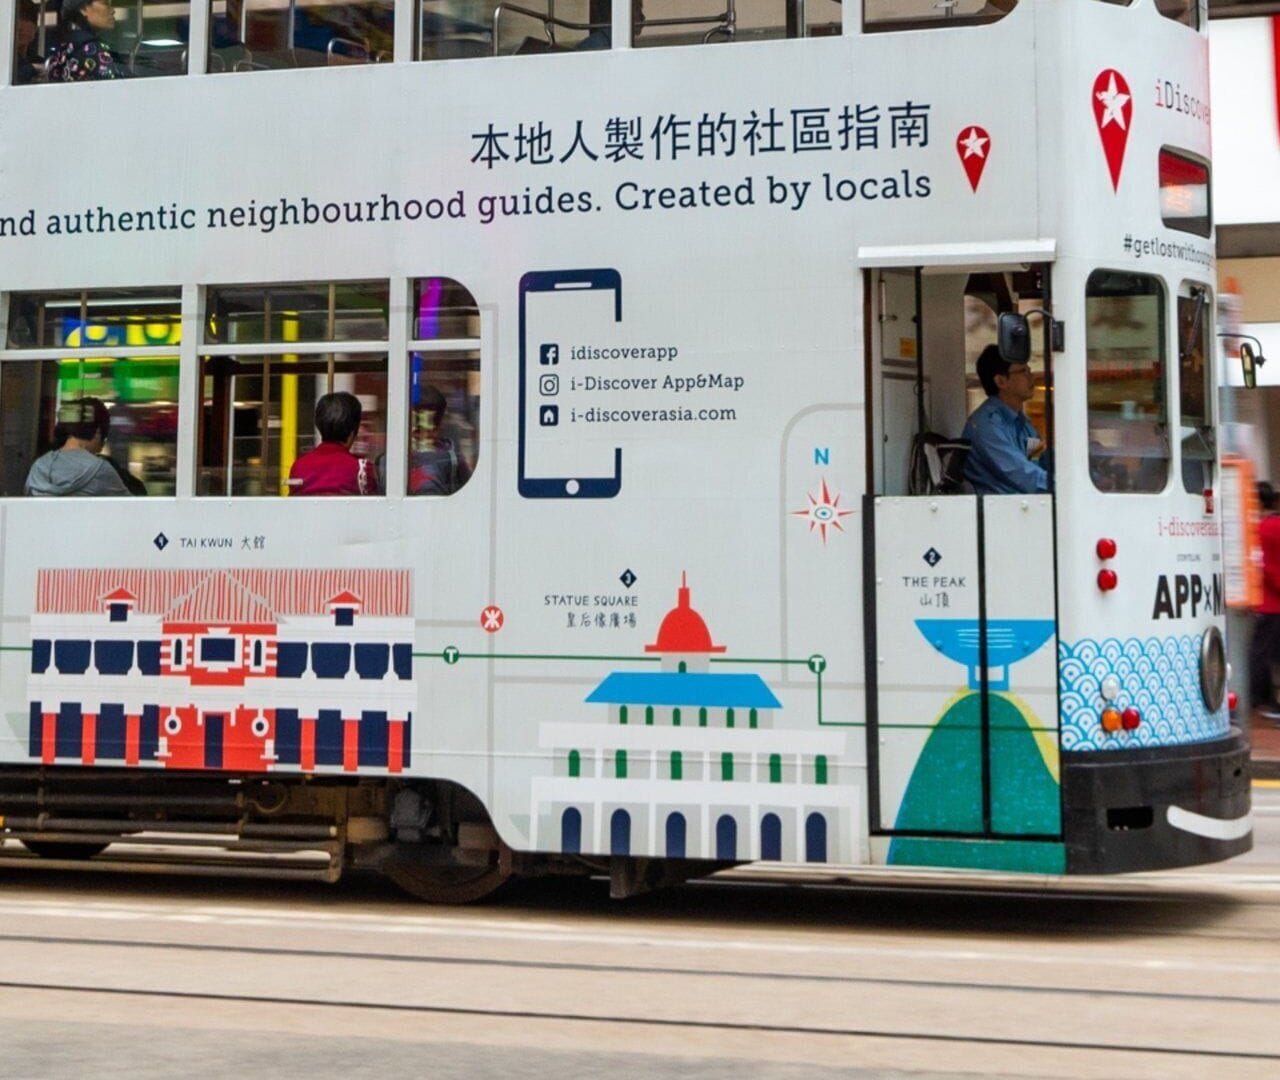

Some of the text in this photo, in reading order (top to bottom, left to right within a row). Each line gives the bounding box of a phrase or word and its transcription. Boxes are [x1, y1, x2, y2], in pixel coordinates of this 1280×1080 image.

[470, 100, 931, 169] 本地人製作的社區指南
[46, 203, 196, 235] authentic
[207, 191, 466, 233] neighbourhood
[478, 186, 602, 223] guides.
[615, 175, 754, 213] Created
[767, 174, 811, 210] by
[824, 169, 931, 202] locals
[571, 344, 678, 362] idiscoverapp
[571, 374, 744, 392] i-Discover App&Map
[571, 407, 736, 423] i-discoverasia.com
[814, 448, 830, 466] N
[180, 538, 197, 548] TAI
[200, 538, 233, 548] KWUN
[902, 576, 966, 588] THE PEAK
[544, 595, 639, 607] STATUE SQUARE
